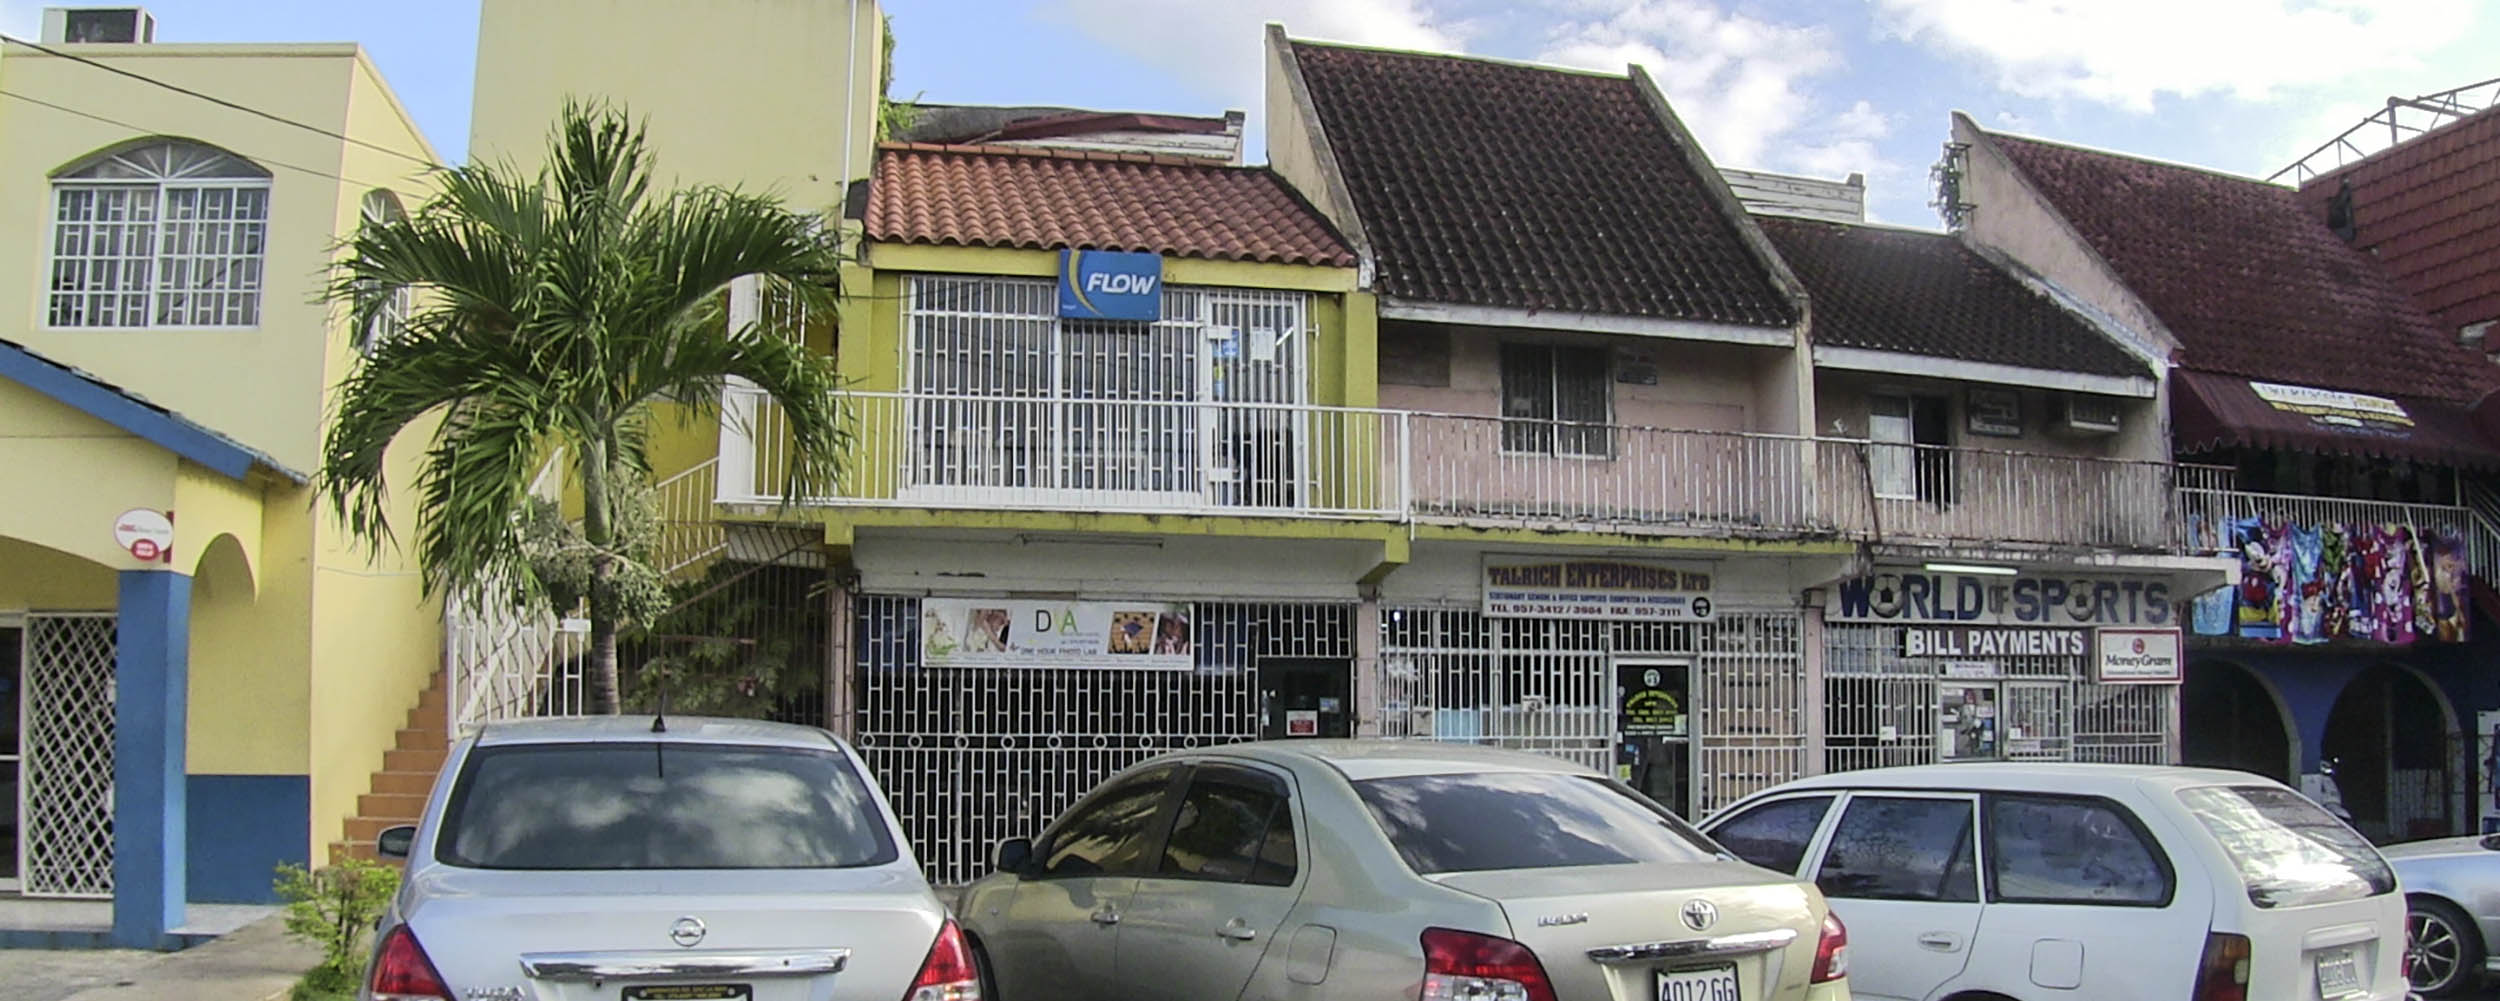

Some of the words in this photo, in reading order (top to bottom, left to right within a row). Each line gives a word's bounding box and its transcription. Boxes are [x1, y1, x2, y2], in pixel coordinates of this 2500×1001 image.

[1087, 272, 1156, 295] FLOW
[1488, 564, 1562, 587] TALRICH
[1565, 562, 1678, 591] ENTERPRISES
[1681, 571, 1711, 592] LTD
[1839, 574, 1984, 620] WORLD
[1987, 585, 2009, 615] OF
[2013, 578, 2169, 624] SPORTS
[1910, 629, 1961, 656] BILL
[1968, 629, 2084, 656] PAYMENTS
[2105, 654, 2172, 669] MoneyGram
